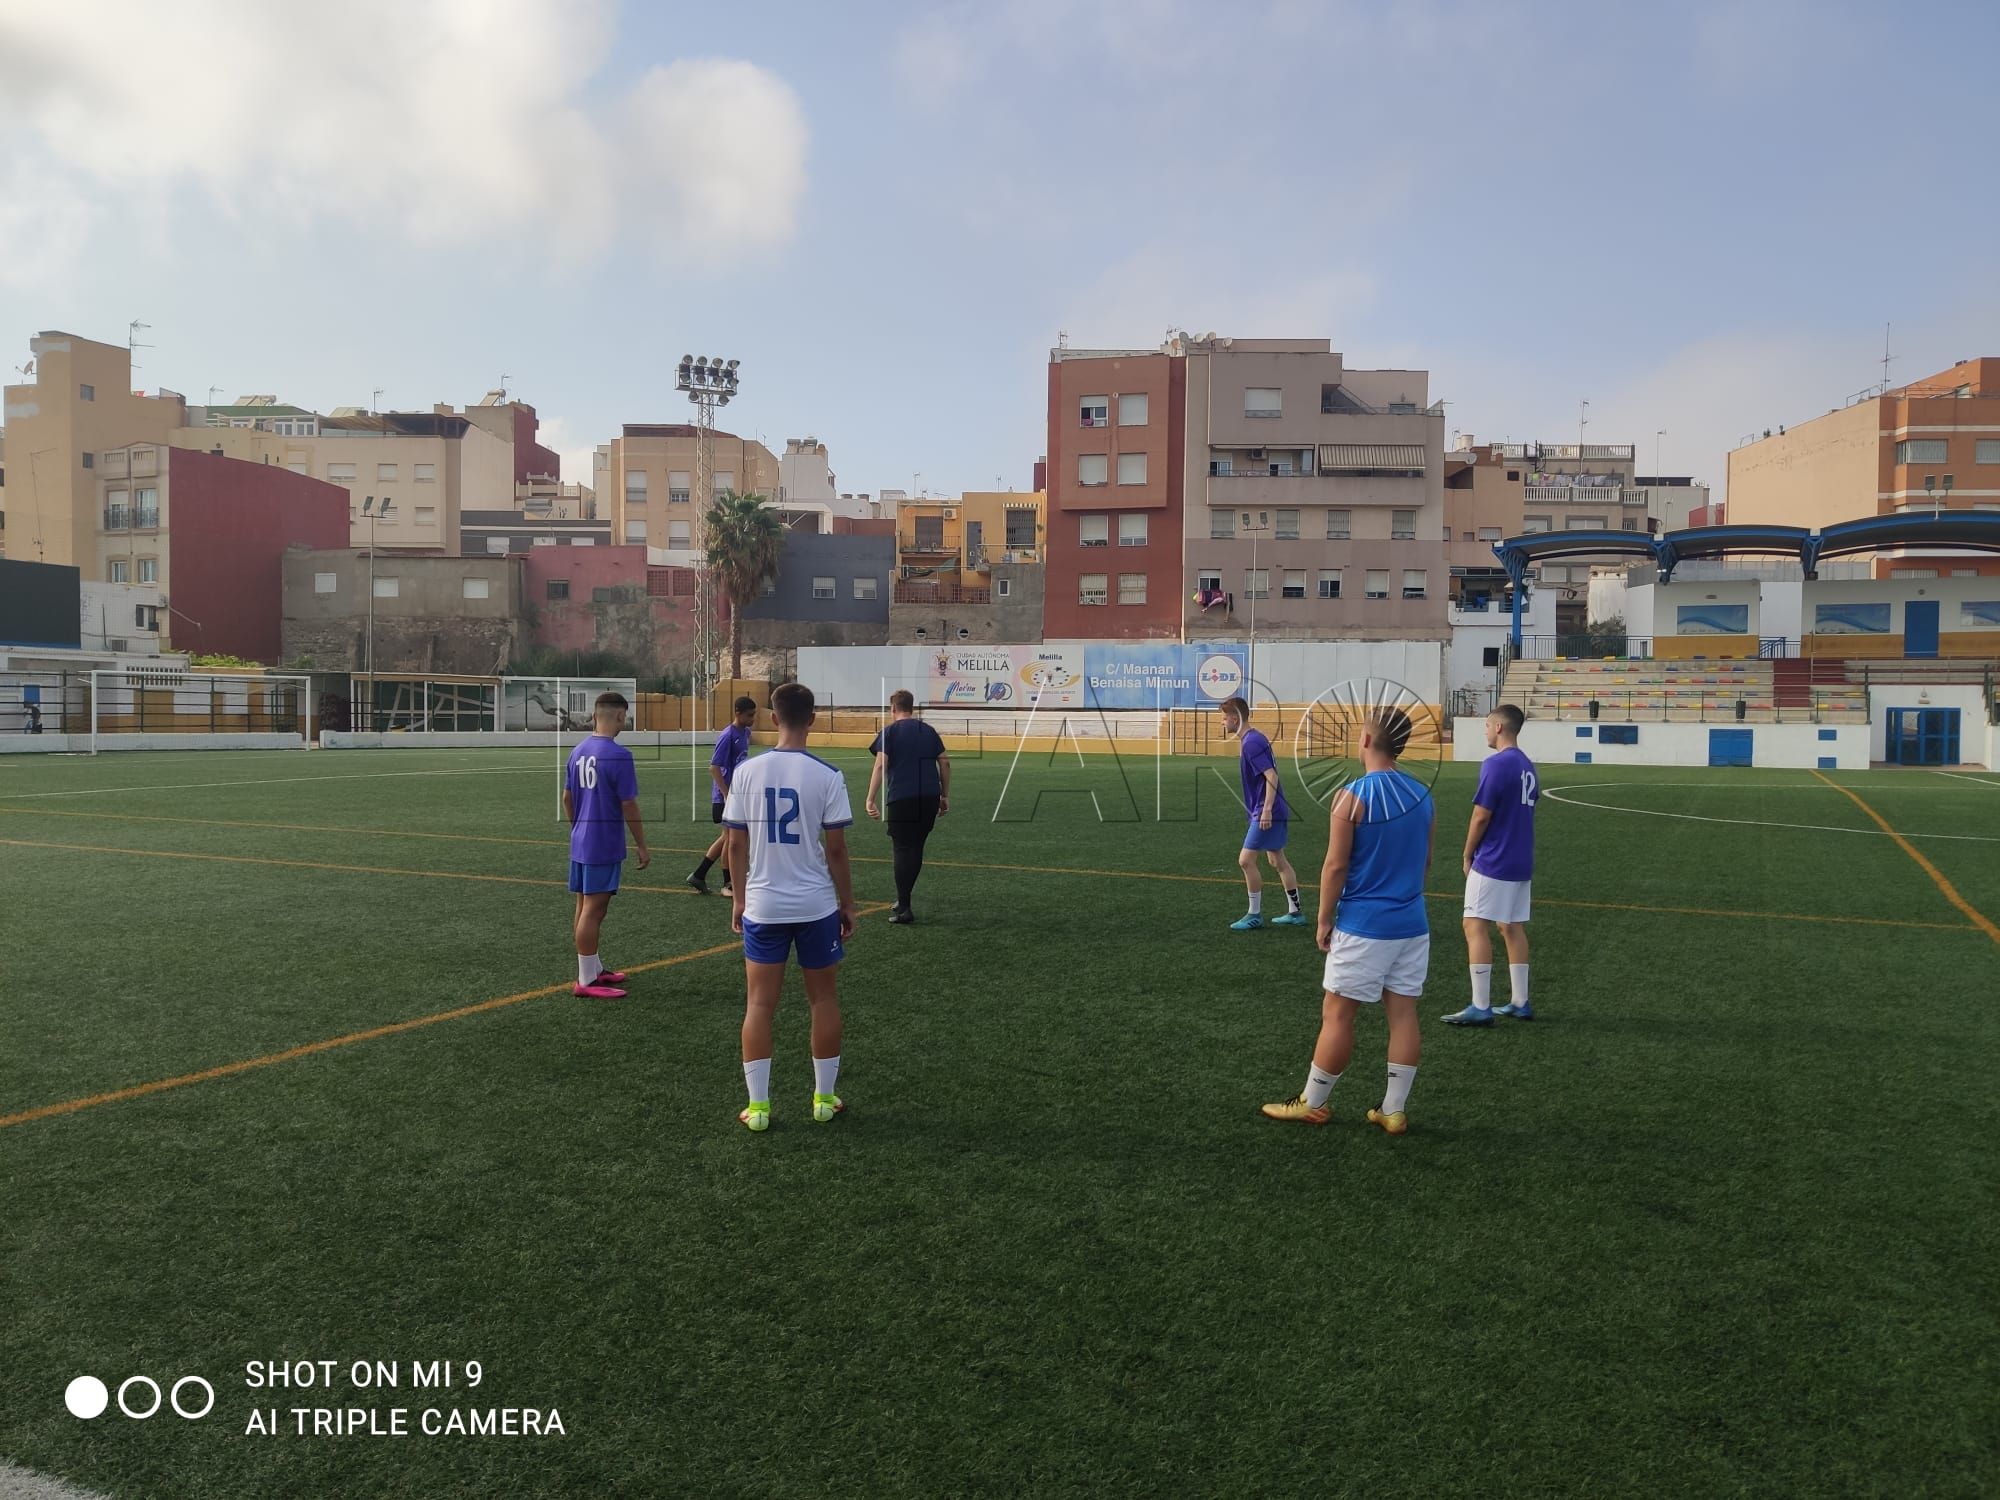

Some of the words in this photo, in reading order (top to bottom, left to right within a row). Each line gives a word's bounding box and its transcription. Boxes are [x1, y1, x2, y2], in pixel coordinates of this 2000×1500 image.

[1038, 653, 1063, 661] Melilla
[957, 659, 1010, 671] MELILLA
[1106, 663, 1119, 676] C/
[1123, 663, 1174, 675] Maanan
[1090, 676, 1142, 688] Benaisa
[1145, 676, 1190, 688] Mimun
[575, 755, 598, 790] 16
[1520, 769, 1536, 807] 12
[764, 787, 800, 844] 12
